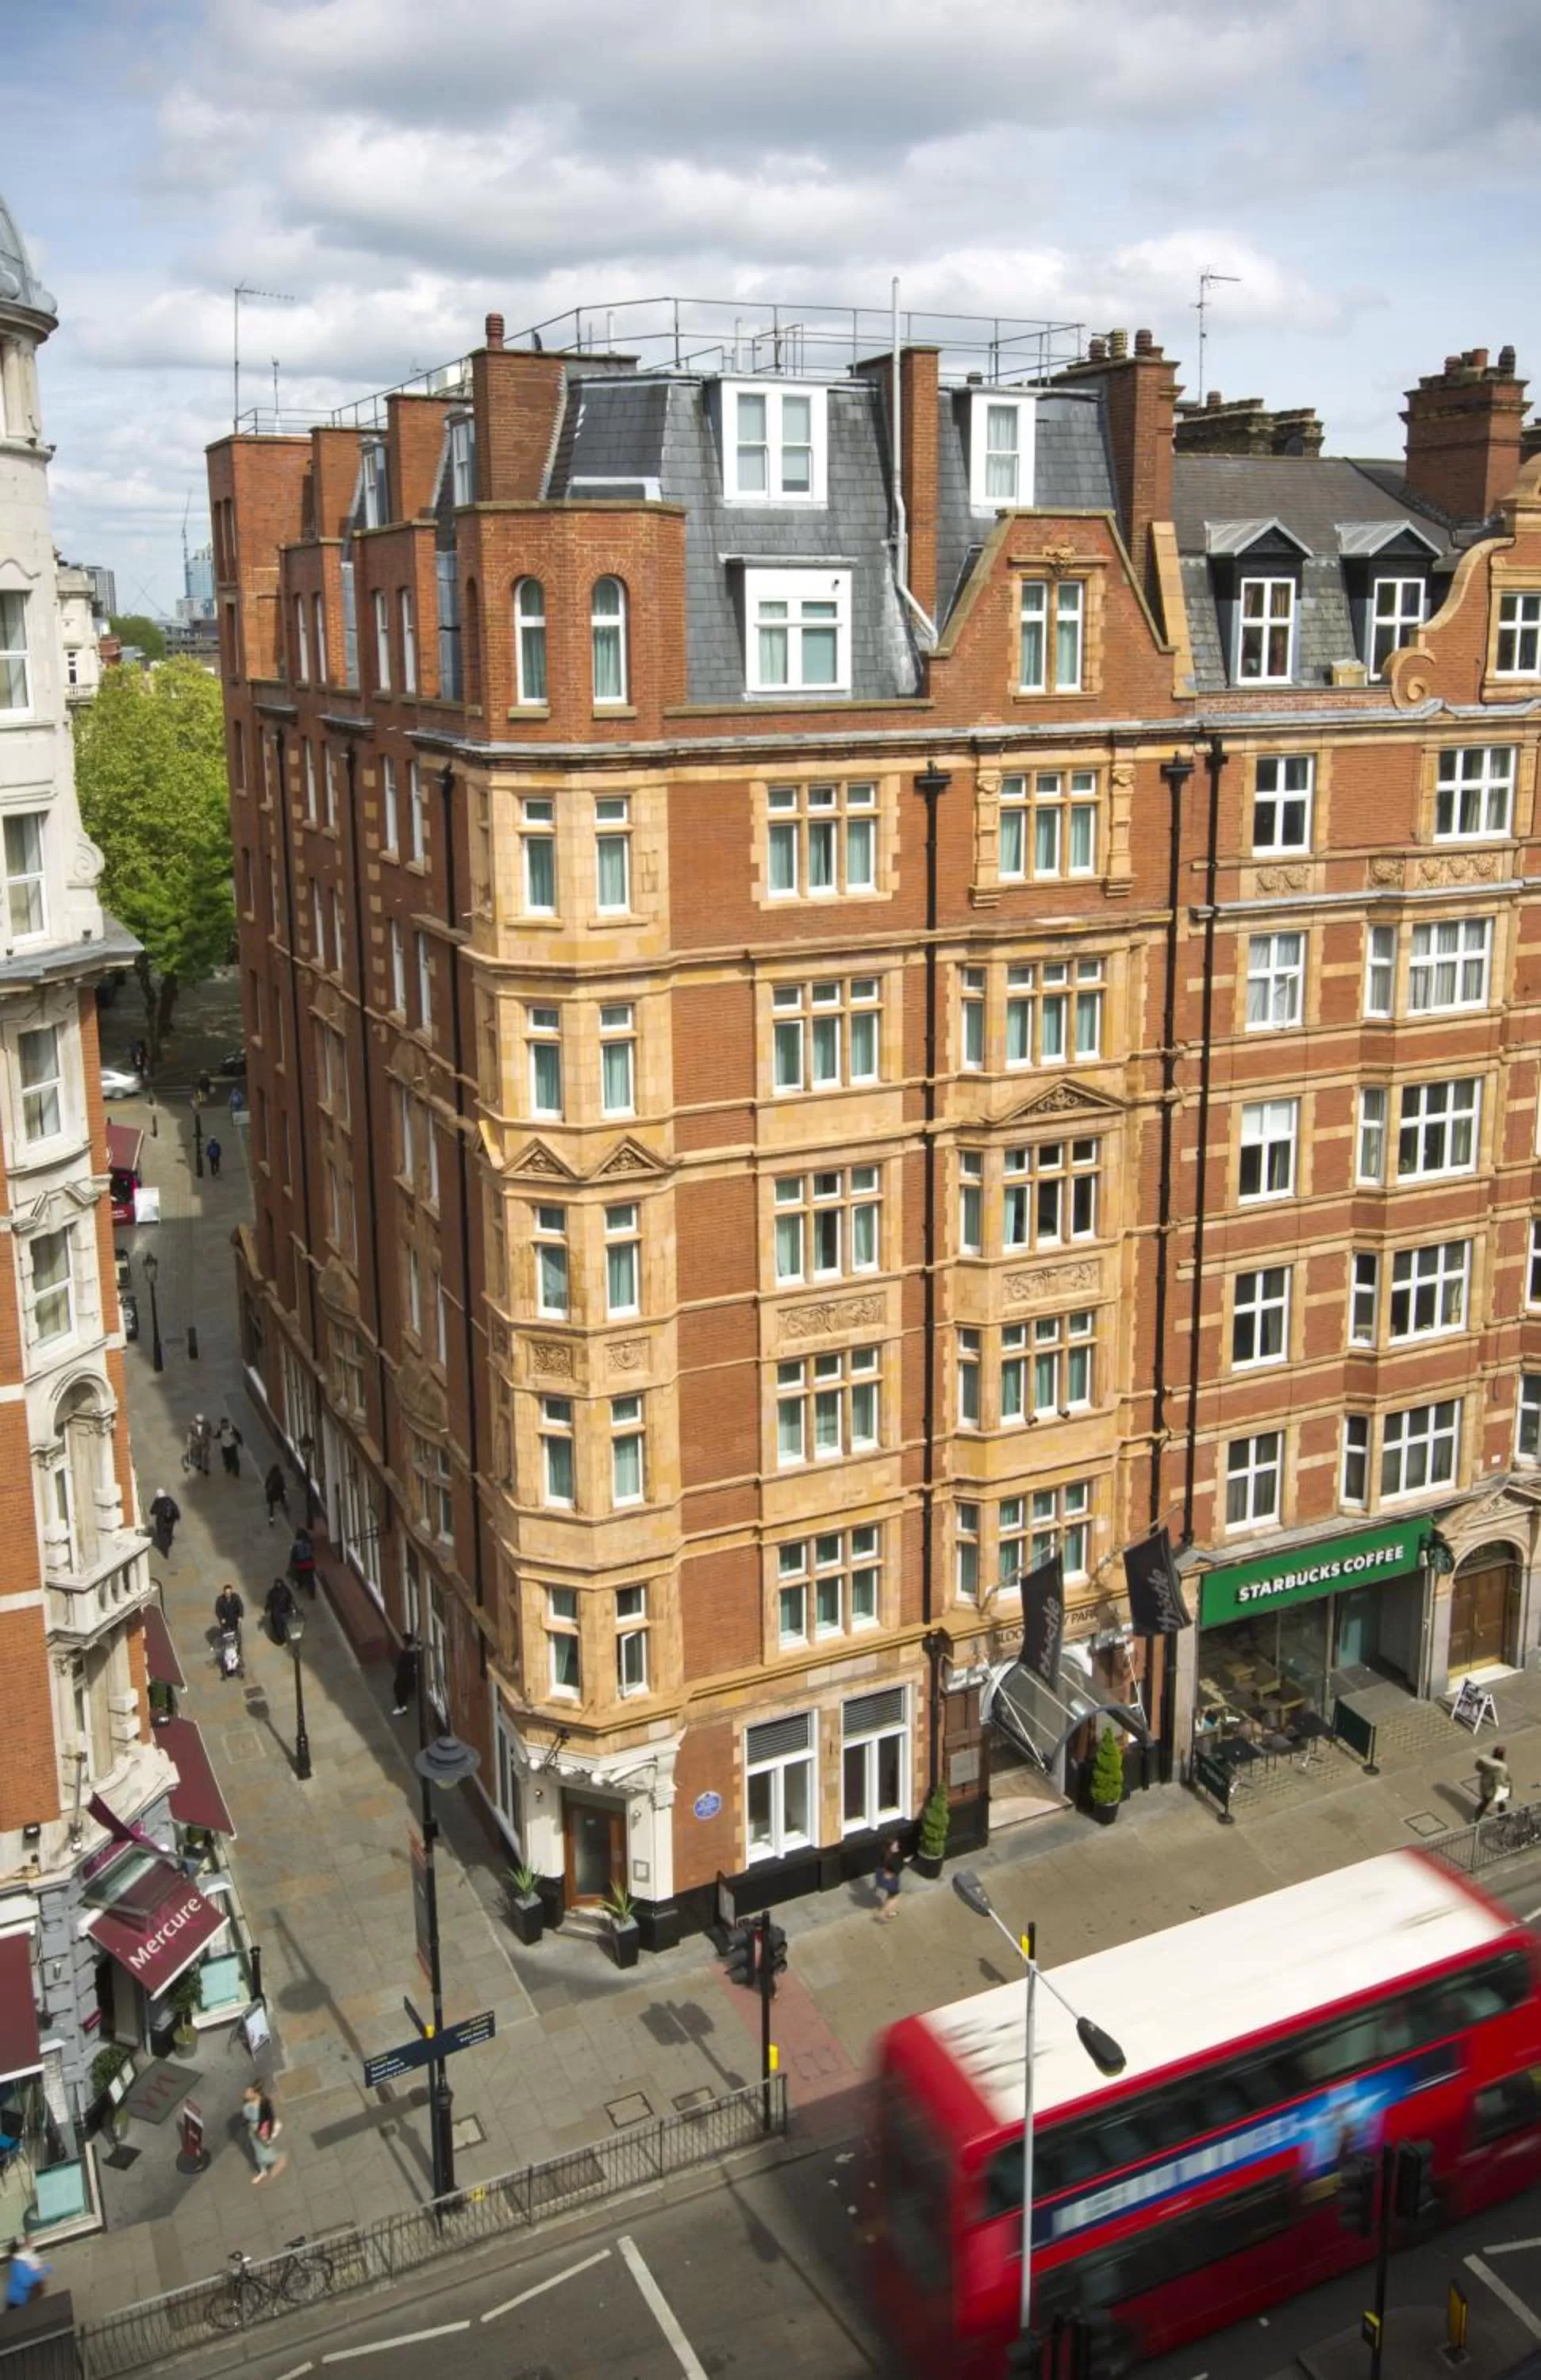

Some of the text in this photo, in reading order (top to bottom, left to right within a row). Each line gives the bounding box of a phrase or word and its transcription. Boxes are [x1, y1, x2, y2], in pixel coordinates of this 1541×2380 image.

[1239, 1545, 1404, 1602] STARBUCKS COFFEE
[129, 1898, 202, 1970] Mercure
